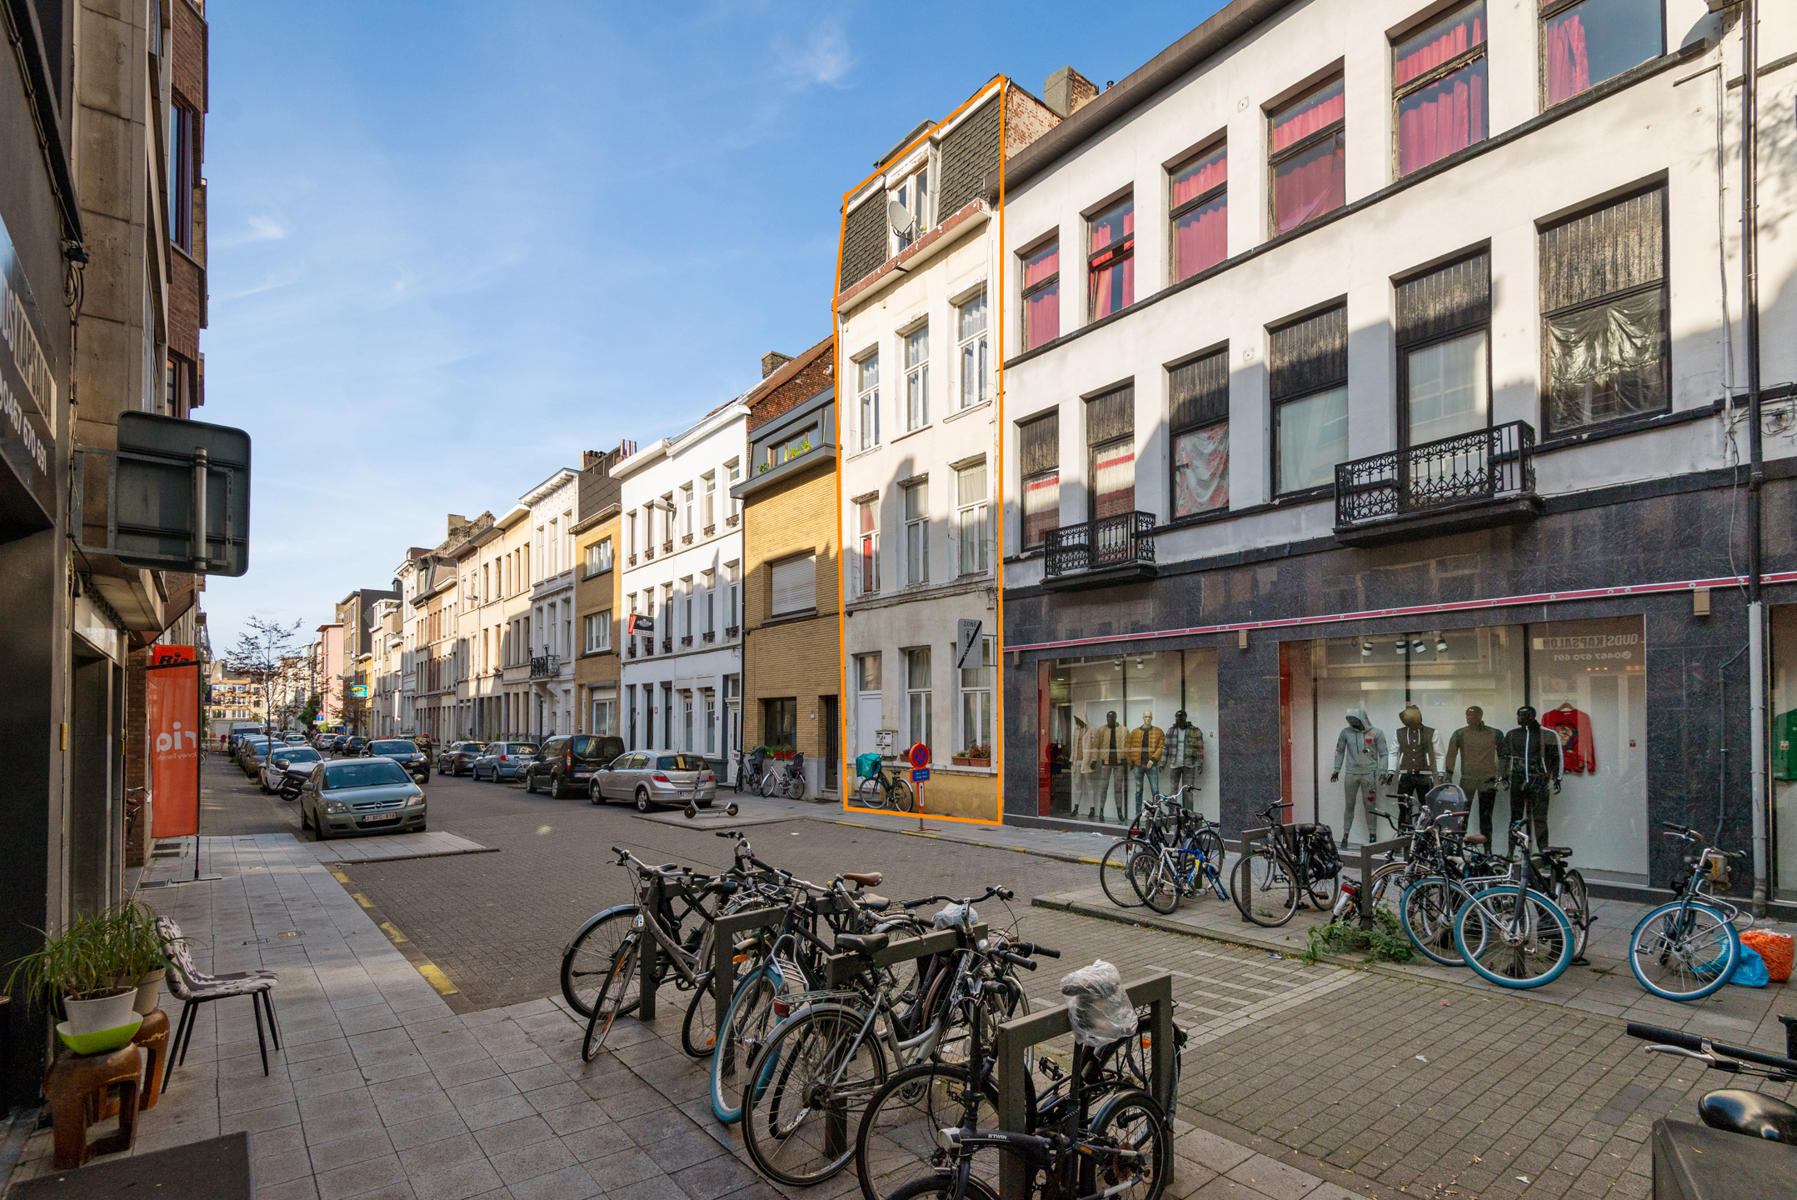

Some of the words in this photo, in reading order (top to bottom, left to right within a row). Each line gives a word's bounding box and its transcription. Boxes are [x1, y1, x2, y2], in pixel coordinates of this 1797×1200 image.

[3, 380, 22, 435] 0467
[23, 415, 36, 459] 670
[963, 620, 977, 628] ZONE
